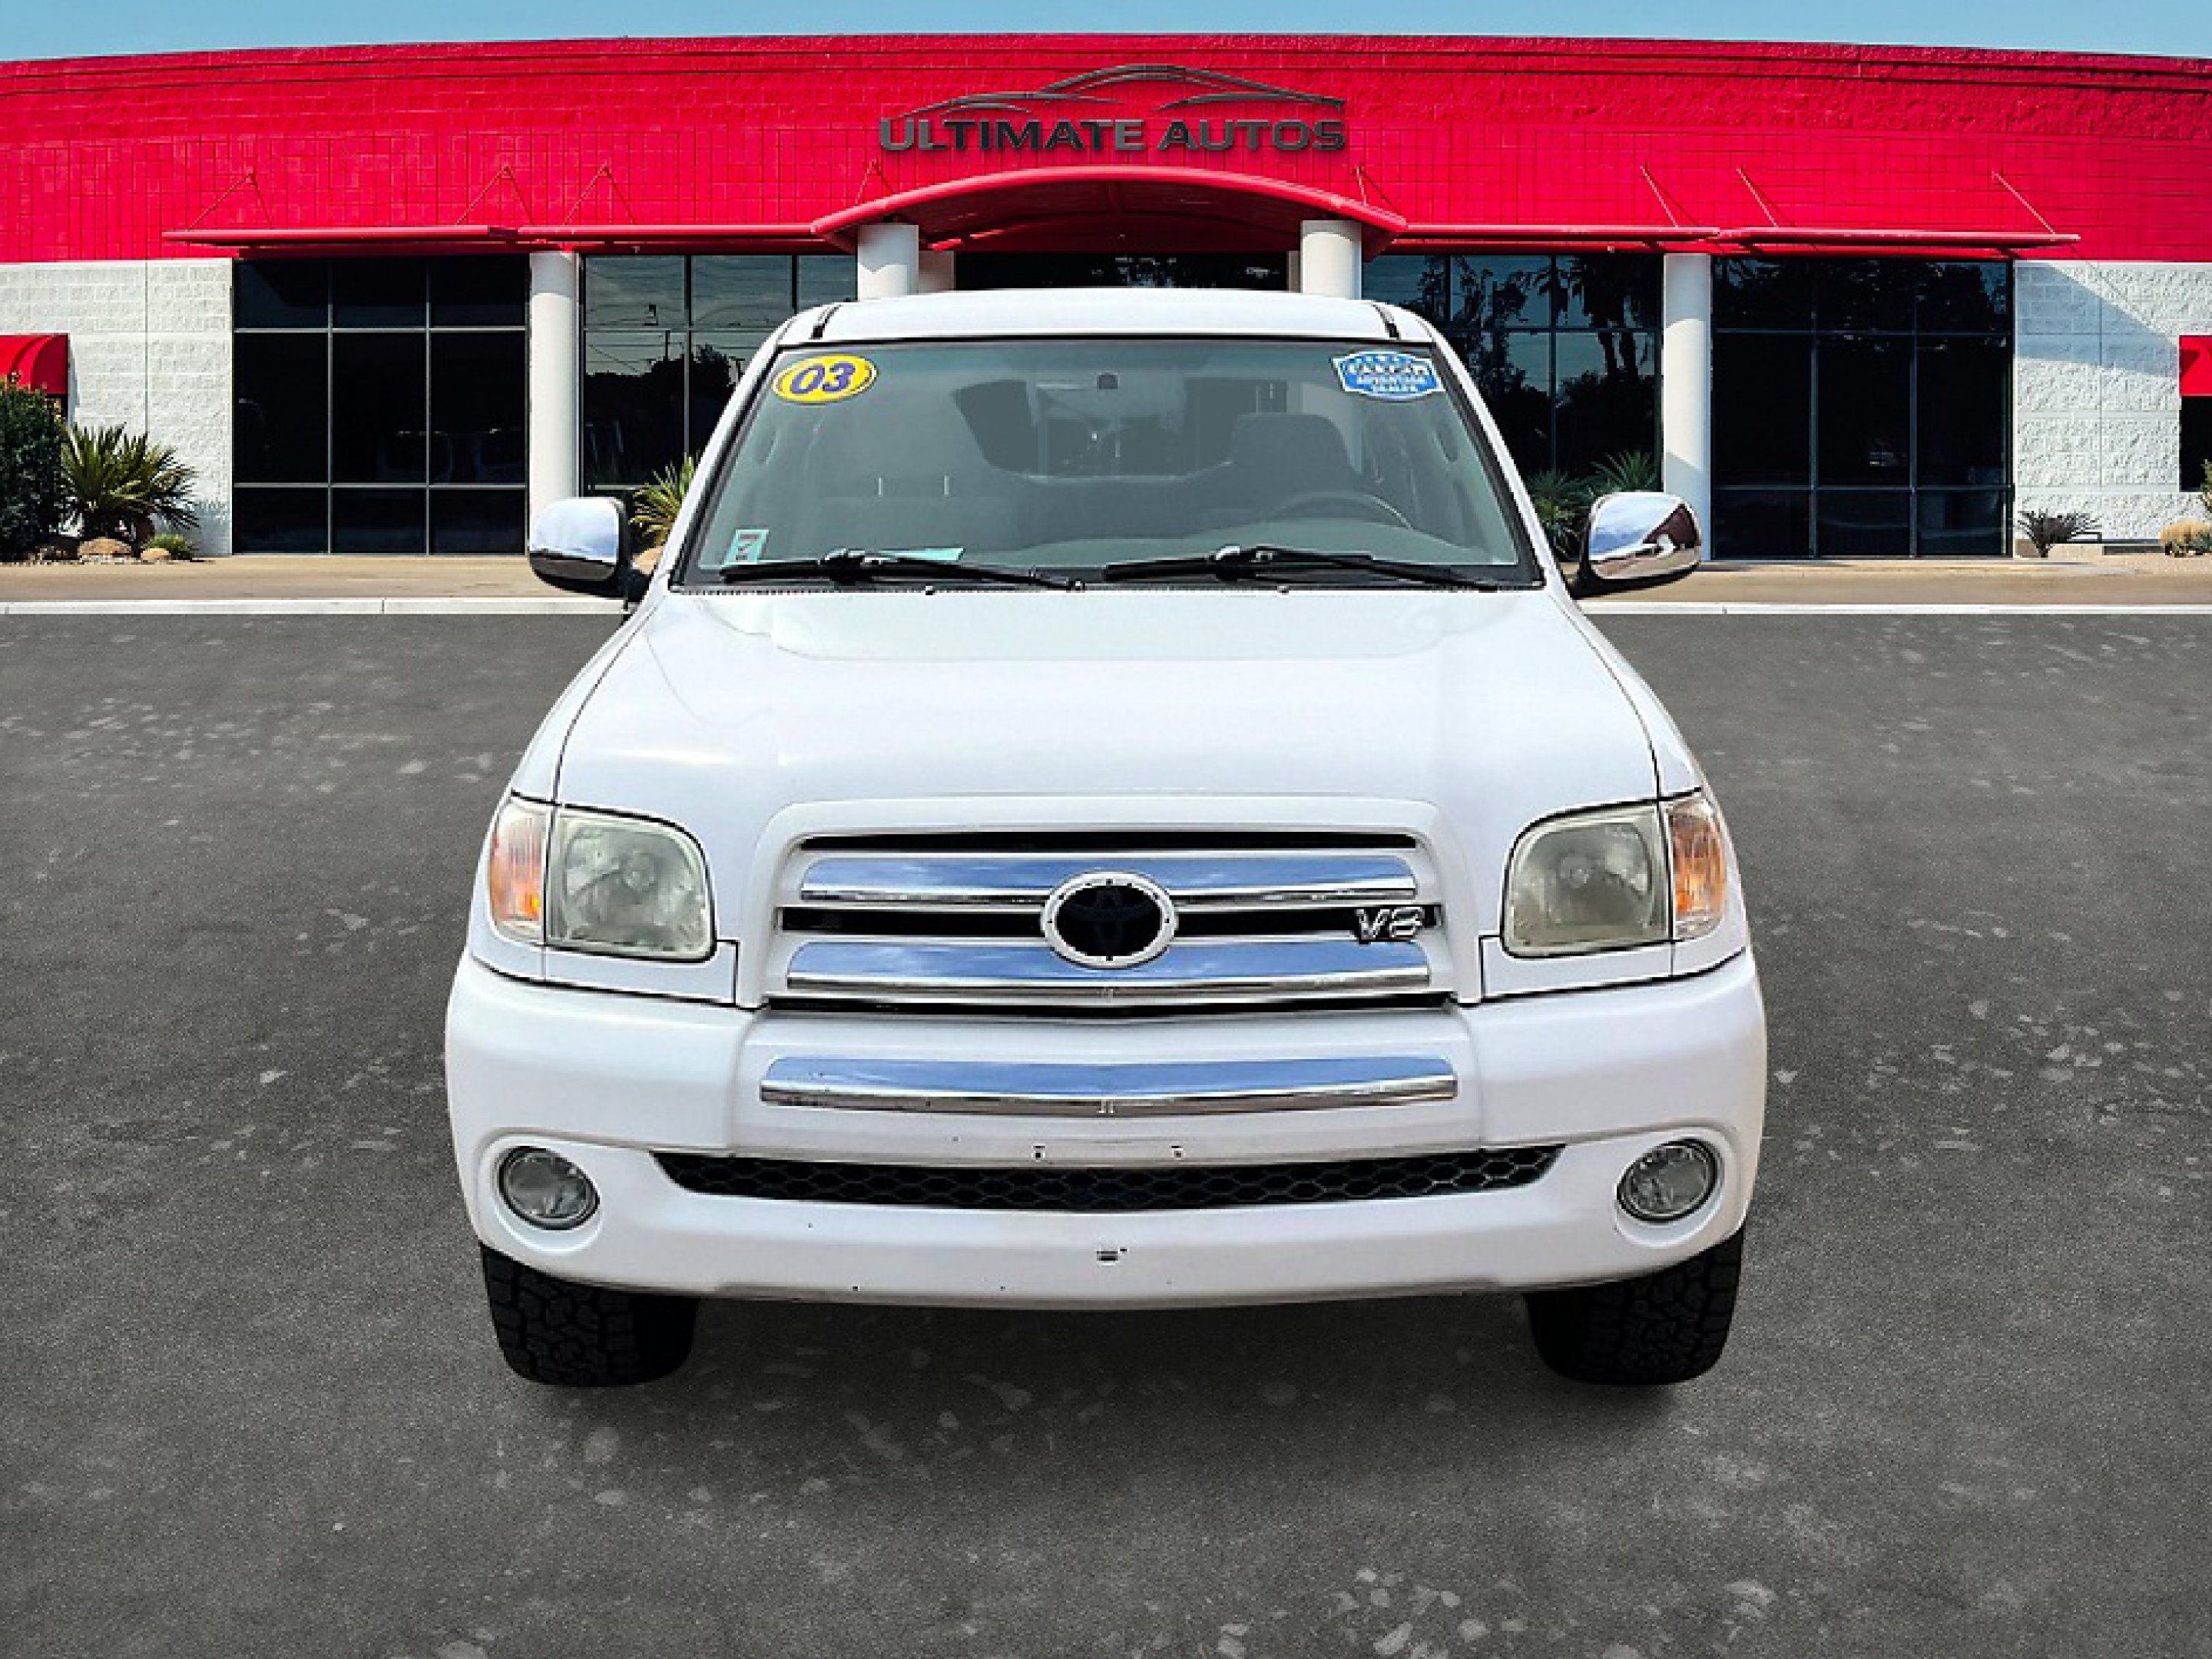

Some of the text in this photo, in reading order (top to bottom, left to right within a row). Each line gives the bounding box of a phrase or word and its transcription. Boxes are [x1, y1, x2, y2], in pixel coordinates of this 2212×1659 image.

[879, 118, 1346, 151] ULTIMATE AUTOS
[791, 362, 856, 394] 03
[1355, 906, 1424, 939] V8
